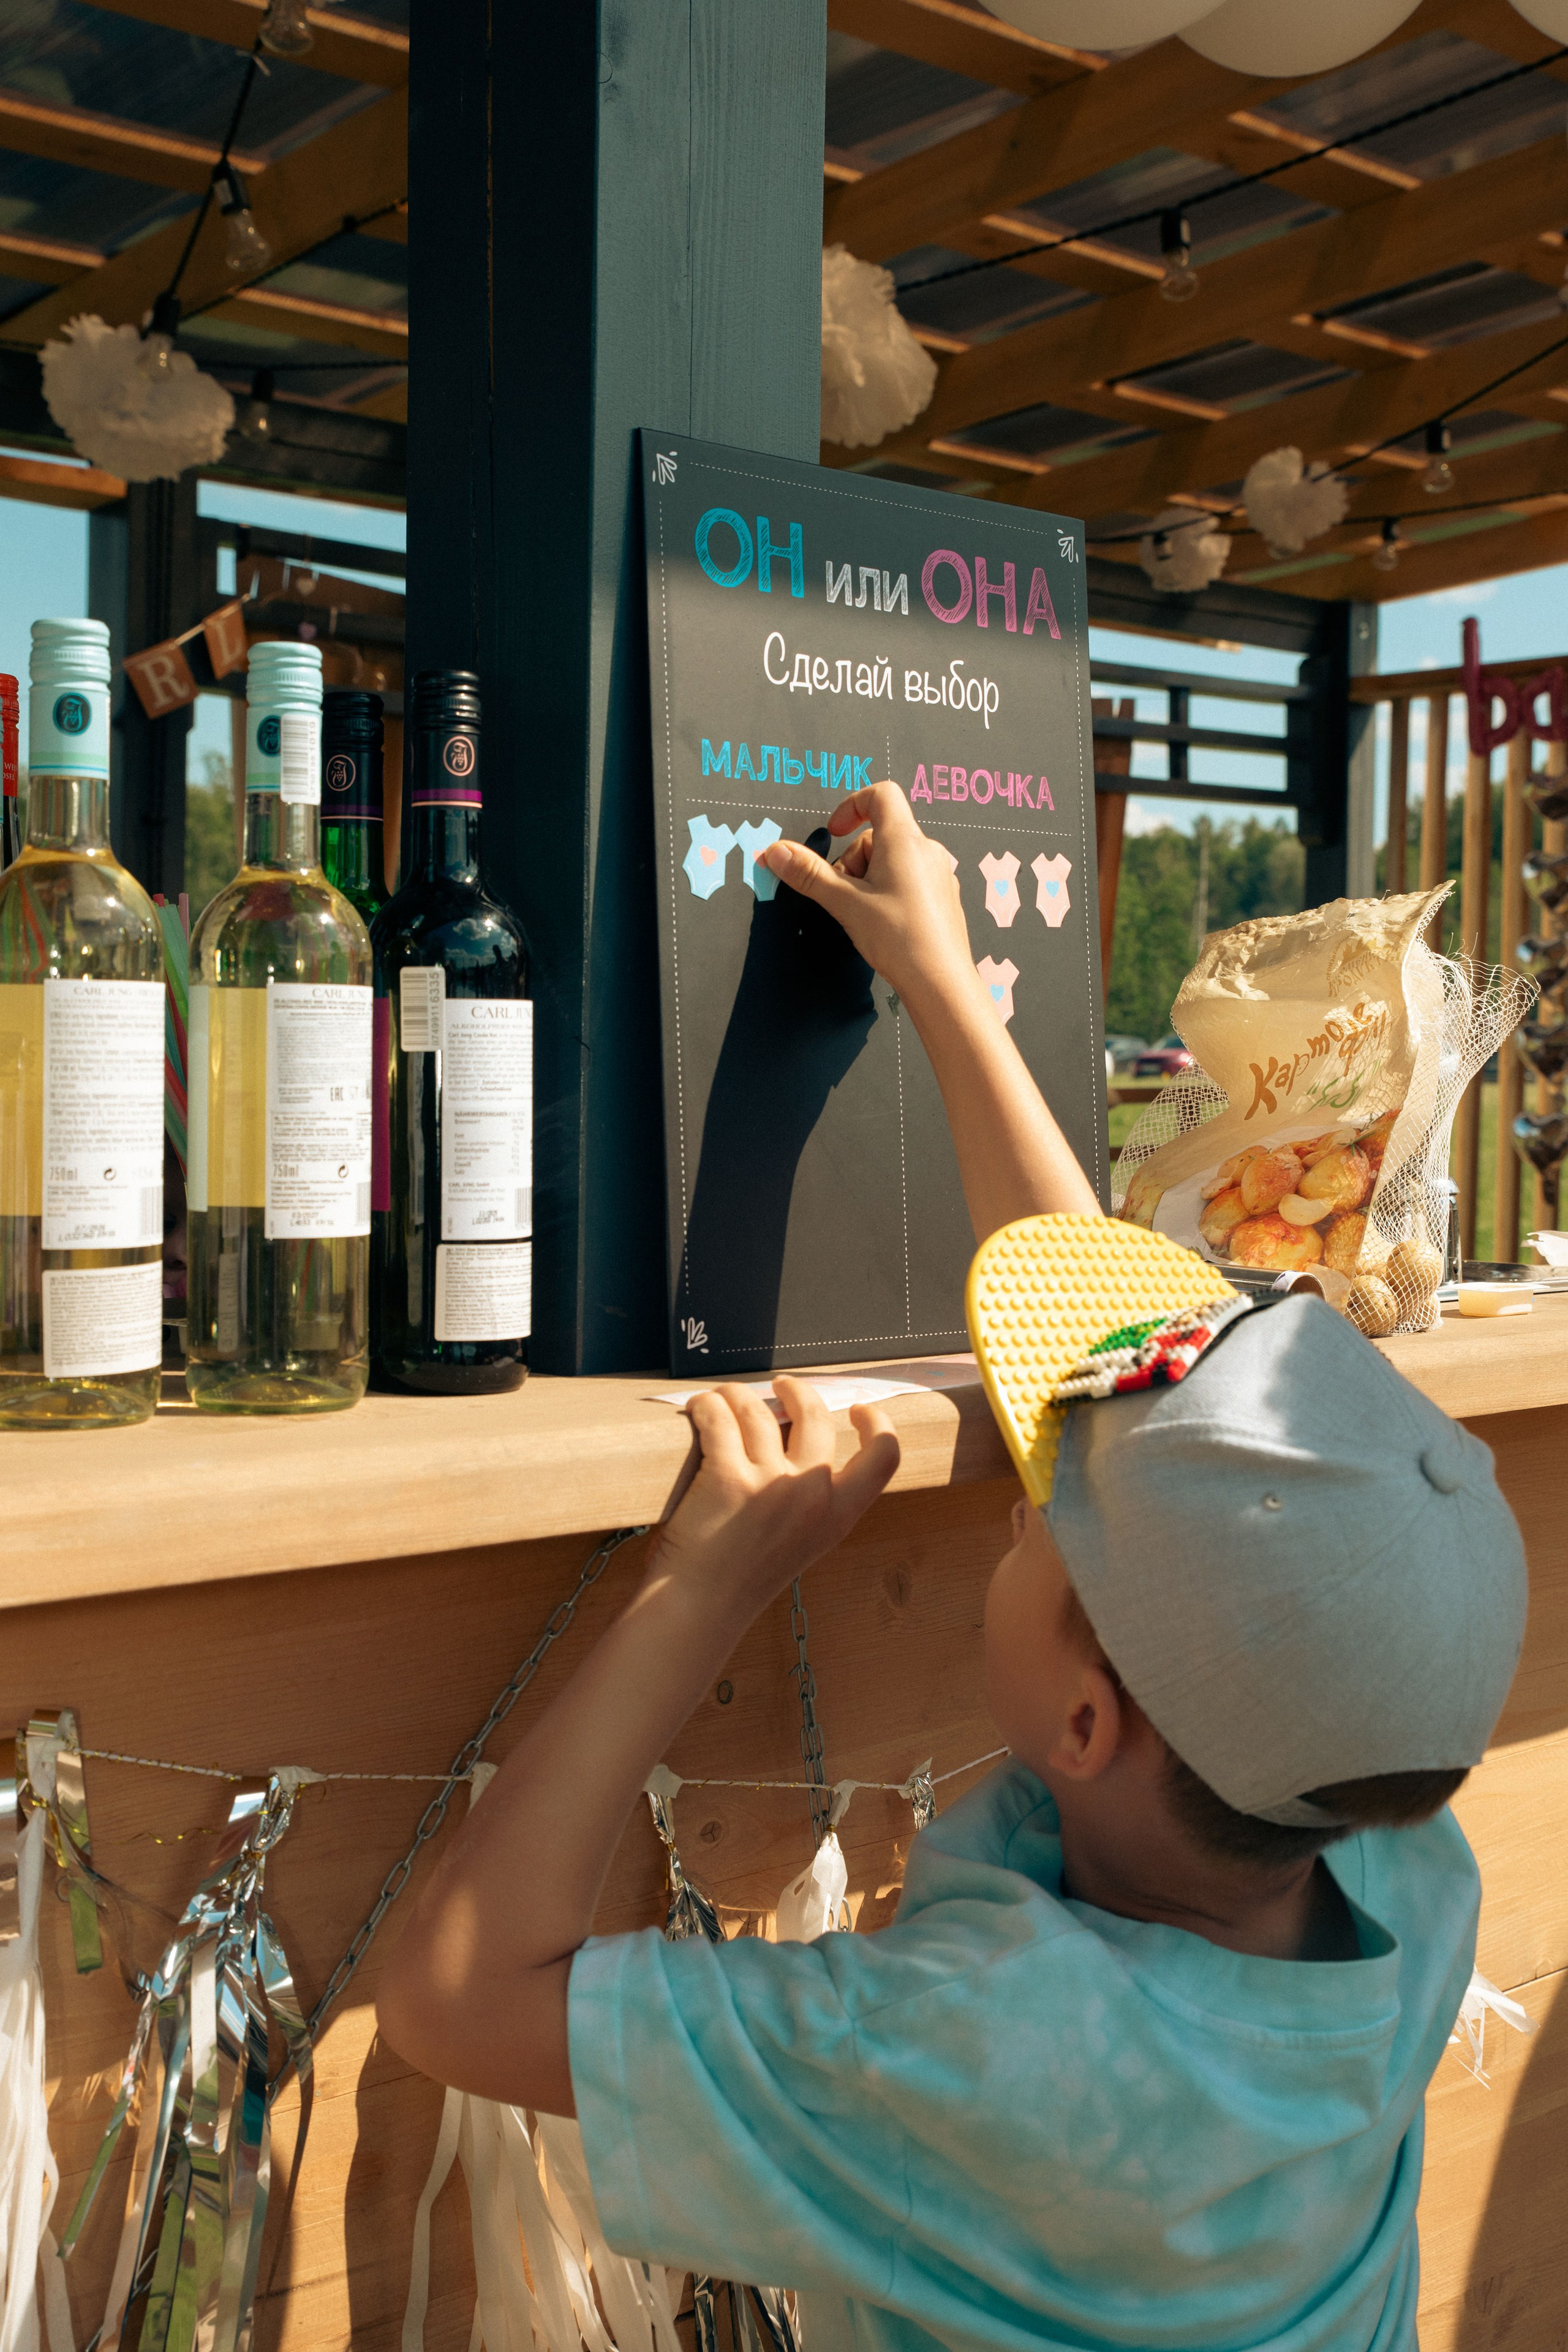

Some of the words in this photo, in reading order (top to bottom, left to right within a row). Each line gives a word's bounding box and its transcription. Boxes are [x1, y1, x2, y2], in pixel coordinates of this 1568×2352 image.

[695, 508, 805, 598] ОН
[921, 549, 1061, 640] ОНА
[763, 631, 893, 700] Сделай
[904, 660, 1000, 729] выбор
[701, 738, 873, 792] МАЛЬЧИК
[910, 764, 1055, 811] ДЕВОЧКА
[472, 1006, 512, 1019] CARL
